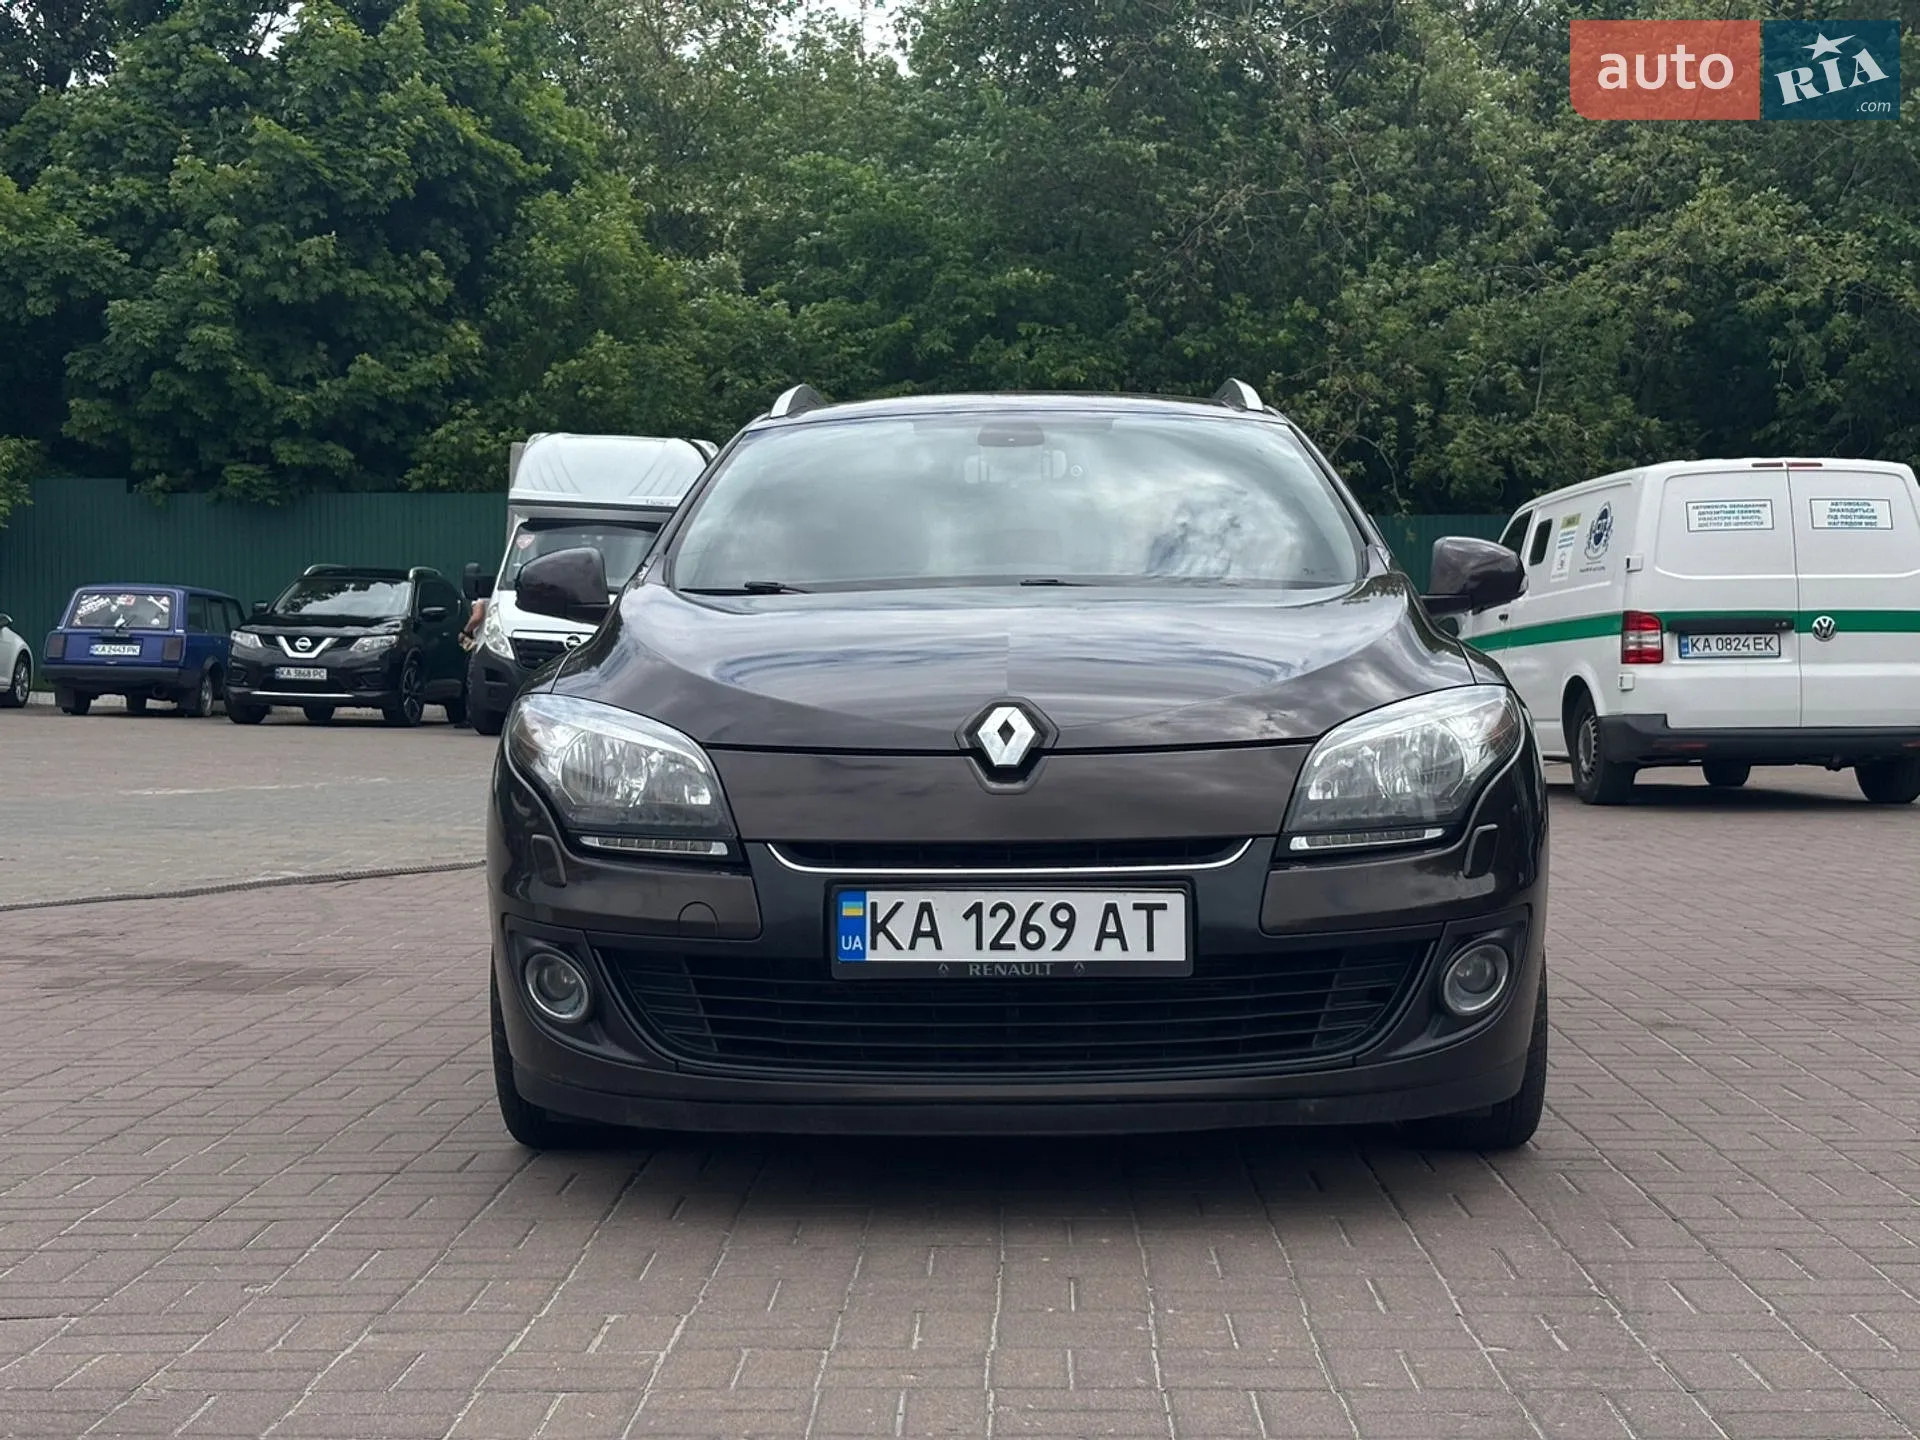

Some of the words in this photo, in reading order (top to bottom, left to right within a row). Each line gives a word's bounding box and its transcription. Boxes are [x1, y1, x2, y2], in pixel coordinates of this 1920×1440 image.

[1690, 637, 1712, 652] KA
[1715, 636, 1751, 651] 0824
[1753, 636, 1775, 651] EK
[869, 901, 943, 951] KA
[961, 901, 1076, 951] 1269
[1094, 902, 1167, 952] AT
[841, 935, 863, 951] UA
[968, 963, 1054, 976] RENAULT
